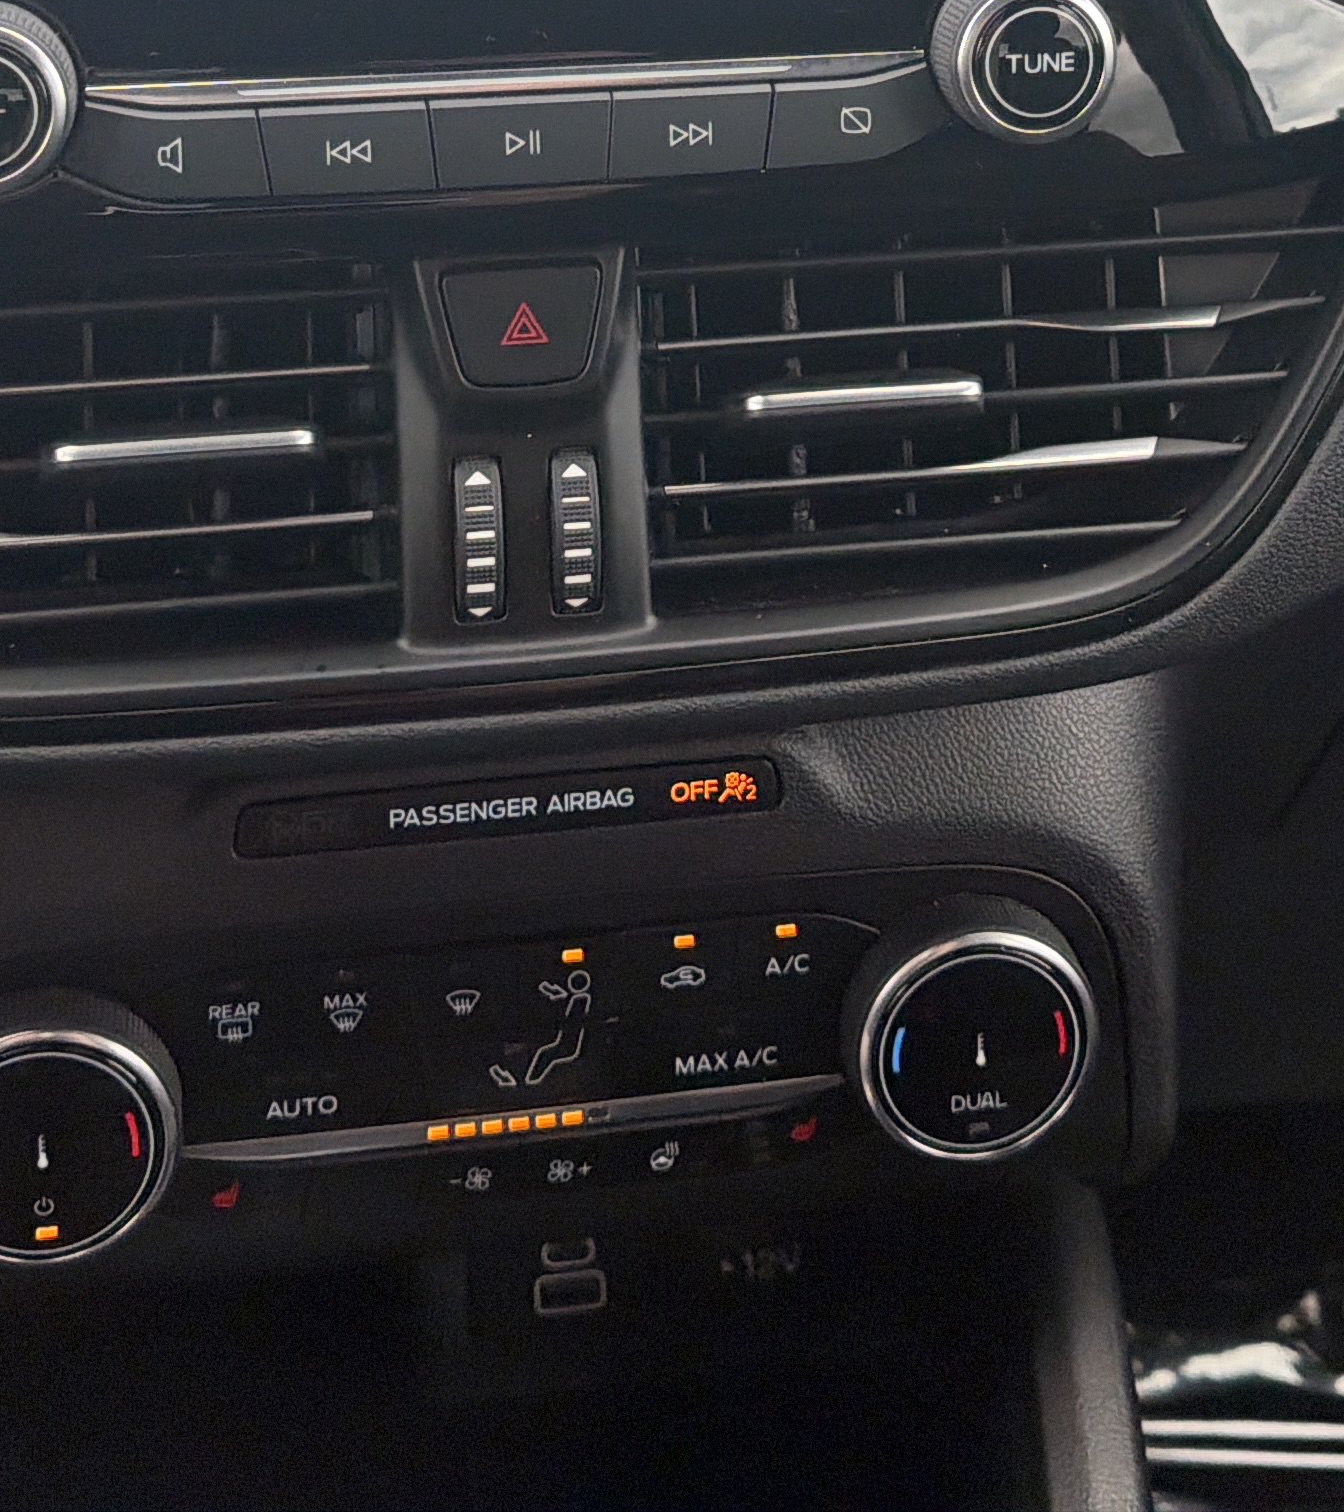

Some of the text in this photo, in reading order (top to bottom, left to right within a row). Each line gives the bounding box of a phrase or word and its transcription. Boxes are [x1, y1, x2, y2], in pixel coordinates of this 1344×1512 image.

[1005, 51, 1076, 75] TUNE
[388, 796, 538, 830] PASSENGER
[546, 787, 636, 816] AIRBAG
[669, 779, 719, 804] OFF
[765, 953, 811, 978] A/C
[208, 1002, 261, 1023] REAR
[323, 992, 368, 1010] MAX
[675, 1046, 779, 1077] MAX A/C
[265, 1095, 339, 1121] AUTO
[950, 1090, 1008, 1113] DUAL
